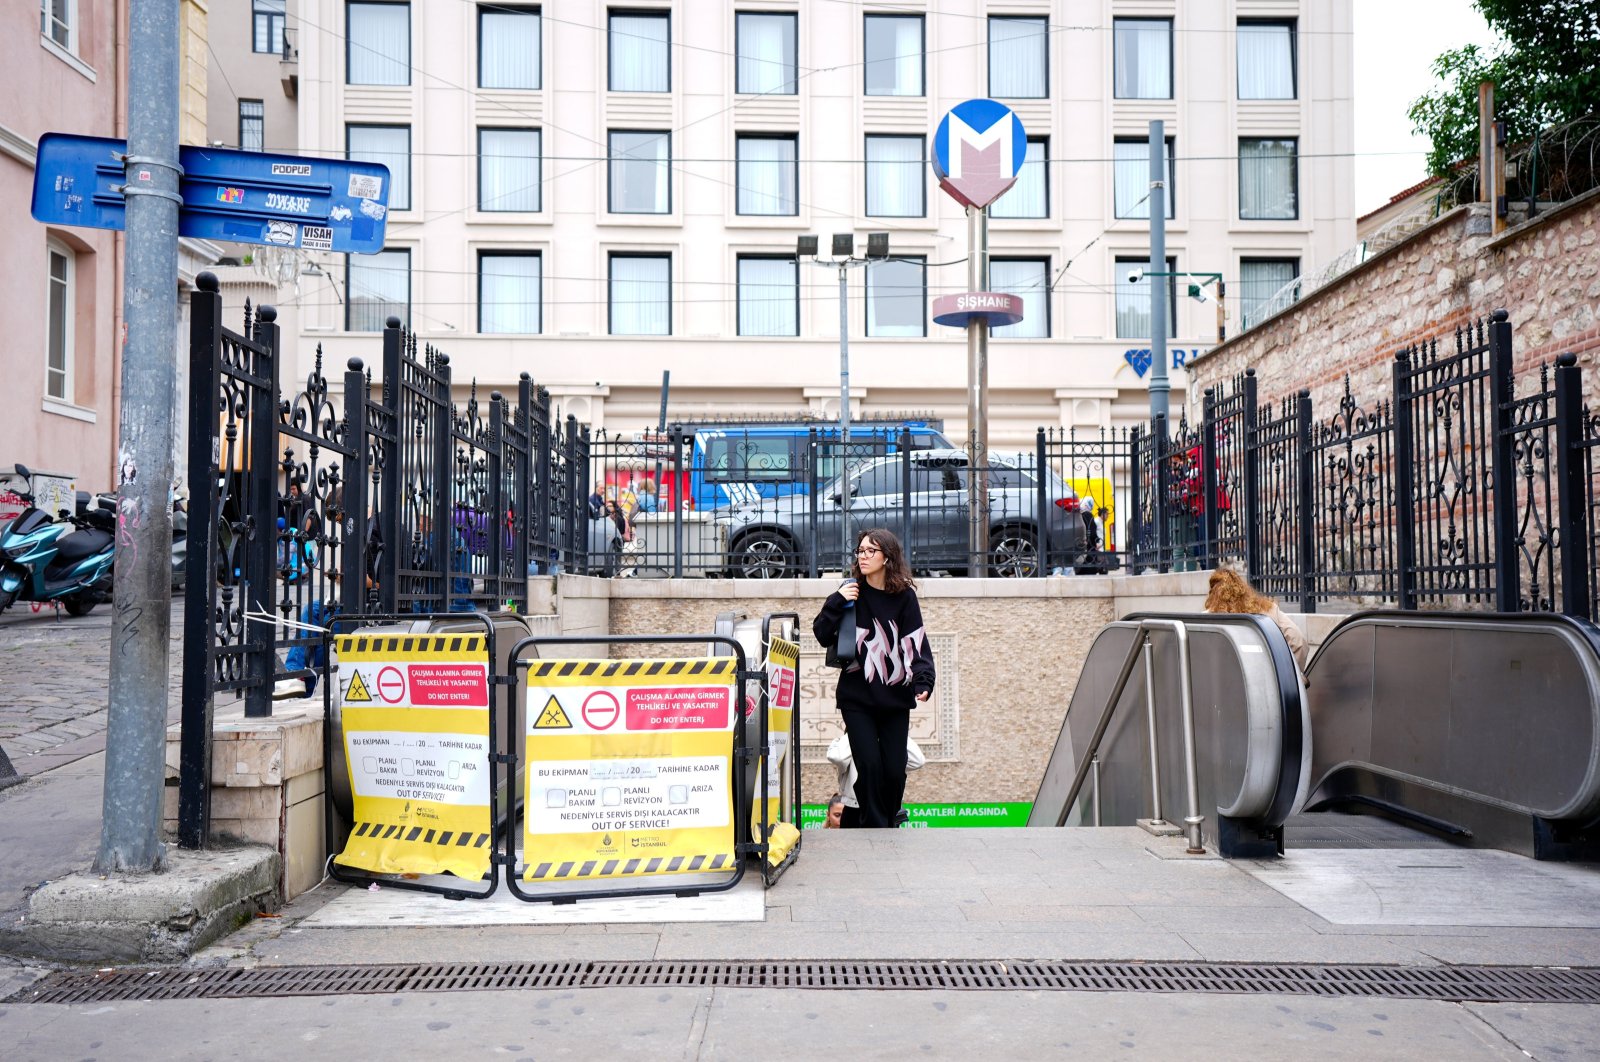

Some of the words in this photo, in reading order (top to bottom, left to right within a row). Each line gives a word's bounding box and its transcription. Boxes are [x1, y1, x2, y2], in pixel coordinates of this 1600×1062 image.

[265, 193, 311, 213] DWARF
[304, 227, 332, 240] VISAH
[957, 294, 1011, 310] ŞİŞHANE
[411, 669, 434, 678] ÇALIŞMA
[461, 669, 482, 677] GİRMEK
[630, 692, 663, 702] ÇALIŞMA
[664, 692, 696, 700] ALANINA
[697, 691, 725, 699] GİRMEK
[636, 702, 670, 710] TEHLİKELİ
[682, 702, 719, 710] YASAKTIR!
[663, 716, 678, 724] NOT
[679, 716, 704, 725] ENTER!
[362, 737, 390, 745] EKİPMAN
[438, 740, 464, 749] TARİHİNE
[464, 742, 482, 750] KADAR
[378, 757, 397, 765] PLANLI
[415, 759, 436, 767] PLANLI
[461, 762, 477, 771] ARIZA
[538, 769, 550, 777] BU
[552, 767, 588, 776] EKİPMAN
[657, 764, 692, 773] TARİHİNE
[693, 764, 720, 772] KADAR
[416, 768, 445, 777] REVİZYON
[375, 778, 405, 787] NEDENİYLE
[405, 780, 425, 788] SERVİS
[425, 782, 436, 790] DIŞI
[436, 783, 465, 792] KALACAKTIR
[691, 784, 714, 793] ARIZA
[396, 789, 411, 798] OUT
[412, 790, 422, 799] OF
[422, 791, 445, 801] SERVICE!
[568, 789, 597, 797] PLANLI
[623, 787, 650, 795] PLANLI
[568, 799, 596, 807] BAKIM
[623, 796, 663, 805] REVİZYON
[560, 811, 604, 820] NEDENİYLE
[606, 809, 632, 818] SERVİS
[634, 809, 650, 819] DIŞI
[651, 808, 700, 817] KALACAKTIR
[912, 806, 956, 817] SAATLERİ
[958, 807, 1008, 817] ARASINDA
[591, 822, 612, 831] OUT
[614, 821, 627, 830] OF
[629, 819, 670, 829] SERVICE!
